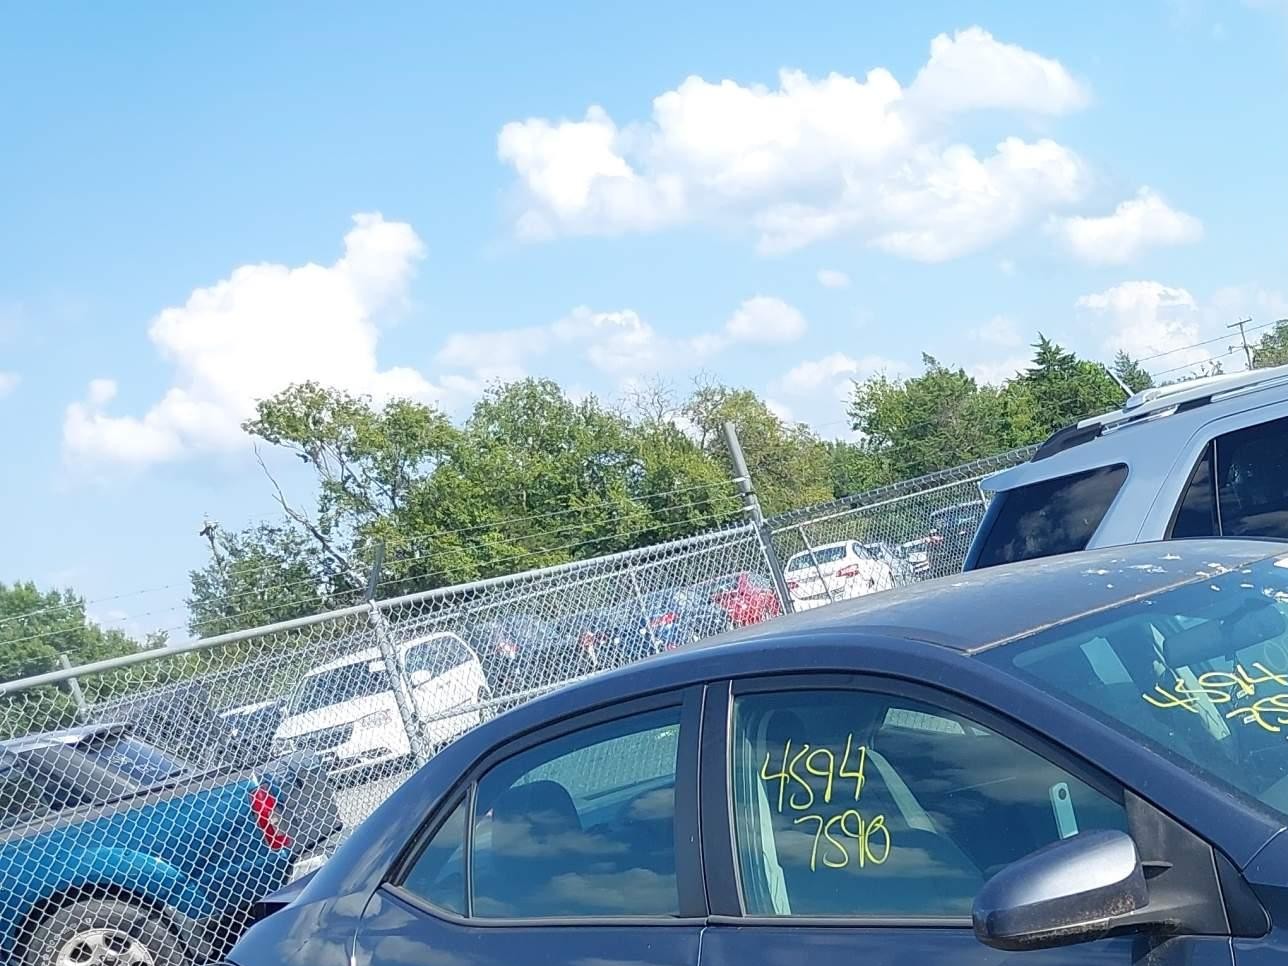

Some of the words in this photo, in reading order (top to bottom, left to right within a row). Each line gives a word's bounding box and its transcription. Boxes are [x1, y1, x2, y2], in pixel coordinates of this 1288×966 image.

[1143, 662, 1288, 714] 4594
[760, 733, 869, 813] 4594
[793, 809, 891, 872] 7590
